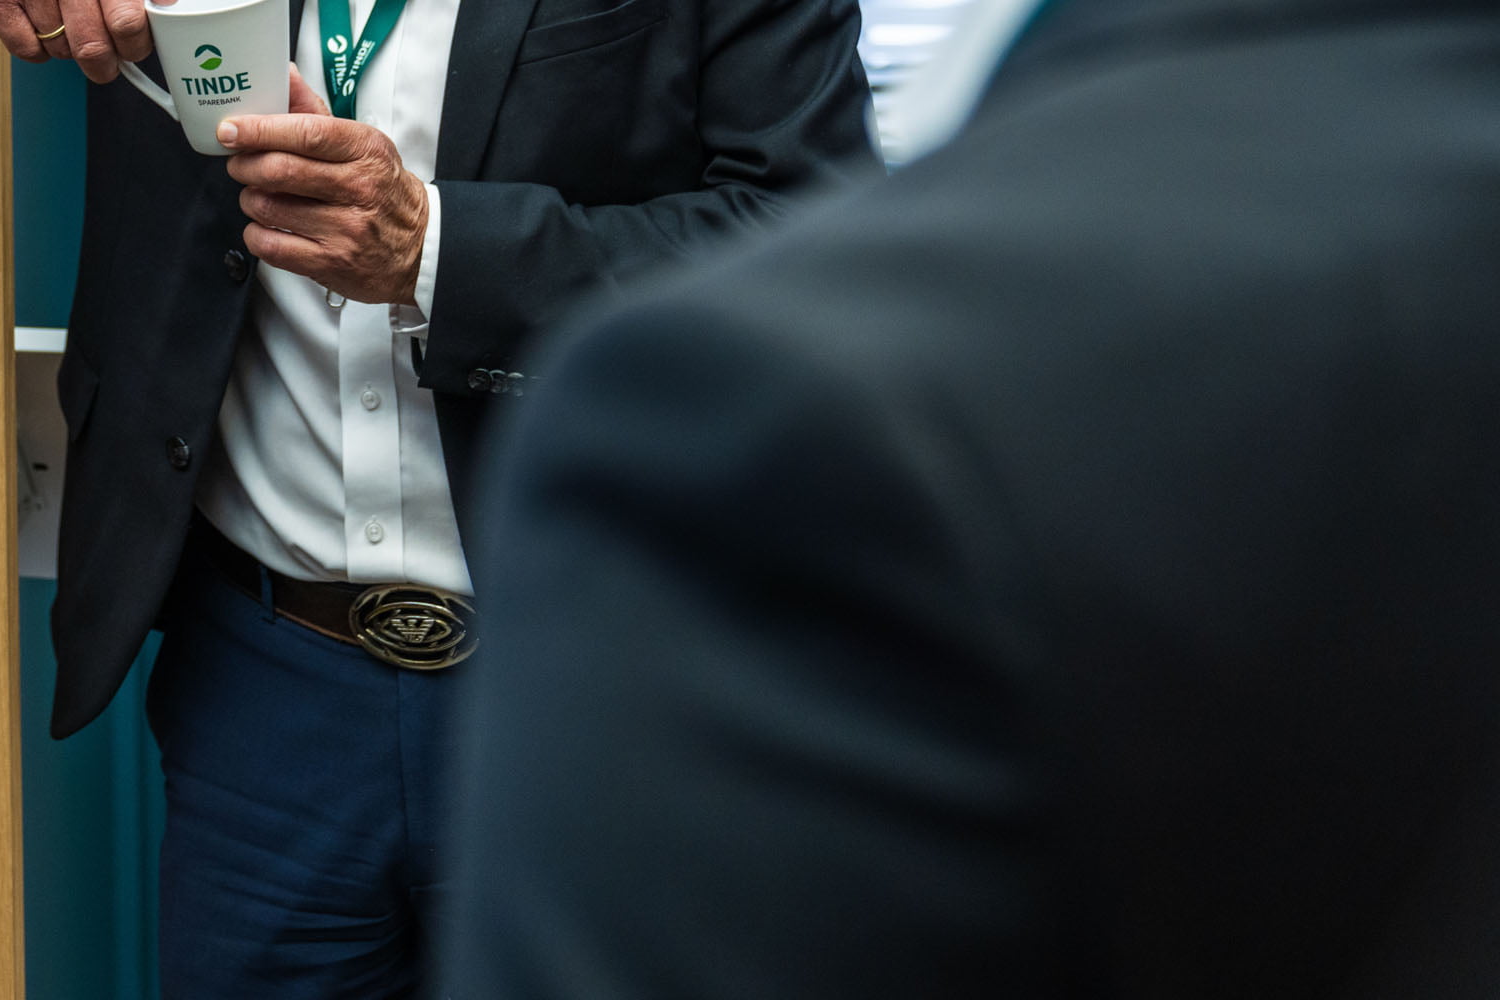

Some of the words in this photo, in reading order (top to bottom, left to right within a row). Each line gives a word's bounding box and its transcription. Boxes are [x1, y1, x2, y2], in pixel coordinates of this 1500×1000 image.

[333, 54, 347, 85] TIN
[349, 39, 372, 77] TINDE
[181, 71, 252, 96] TINDE
[197, 96, 242, 106] SPAREBANK
